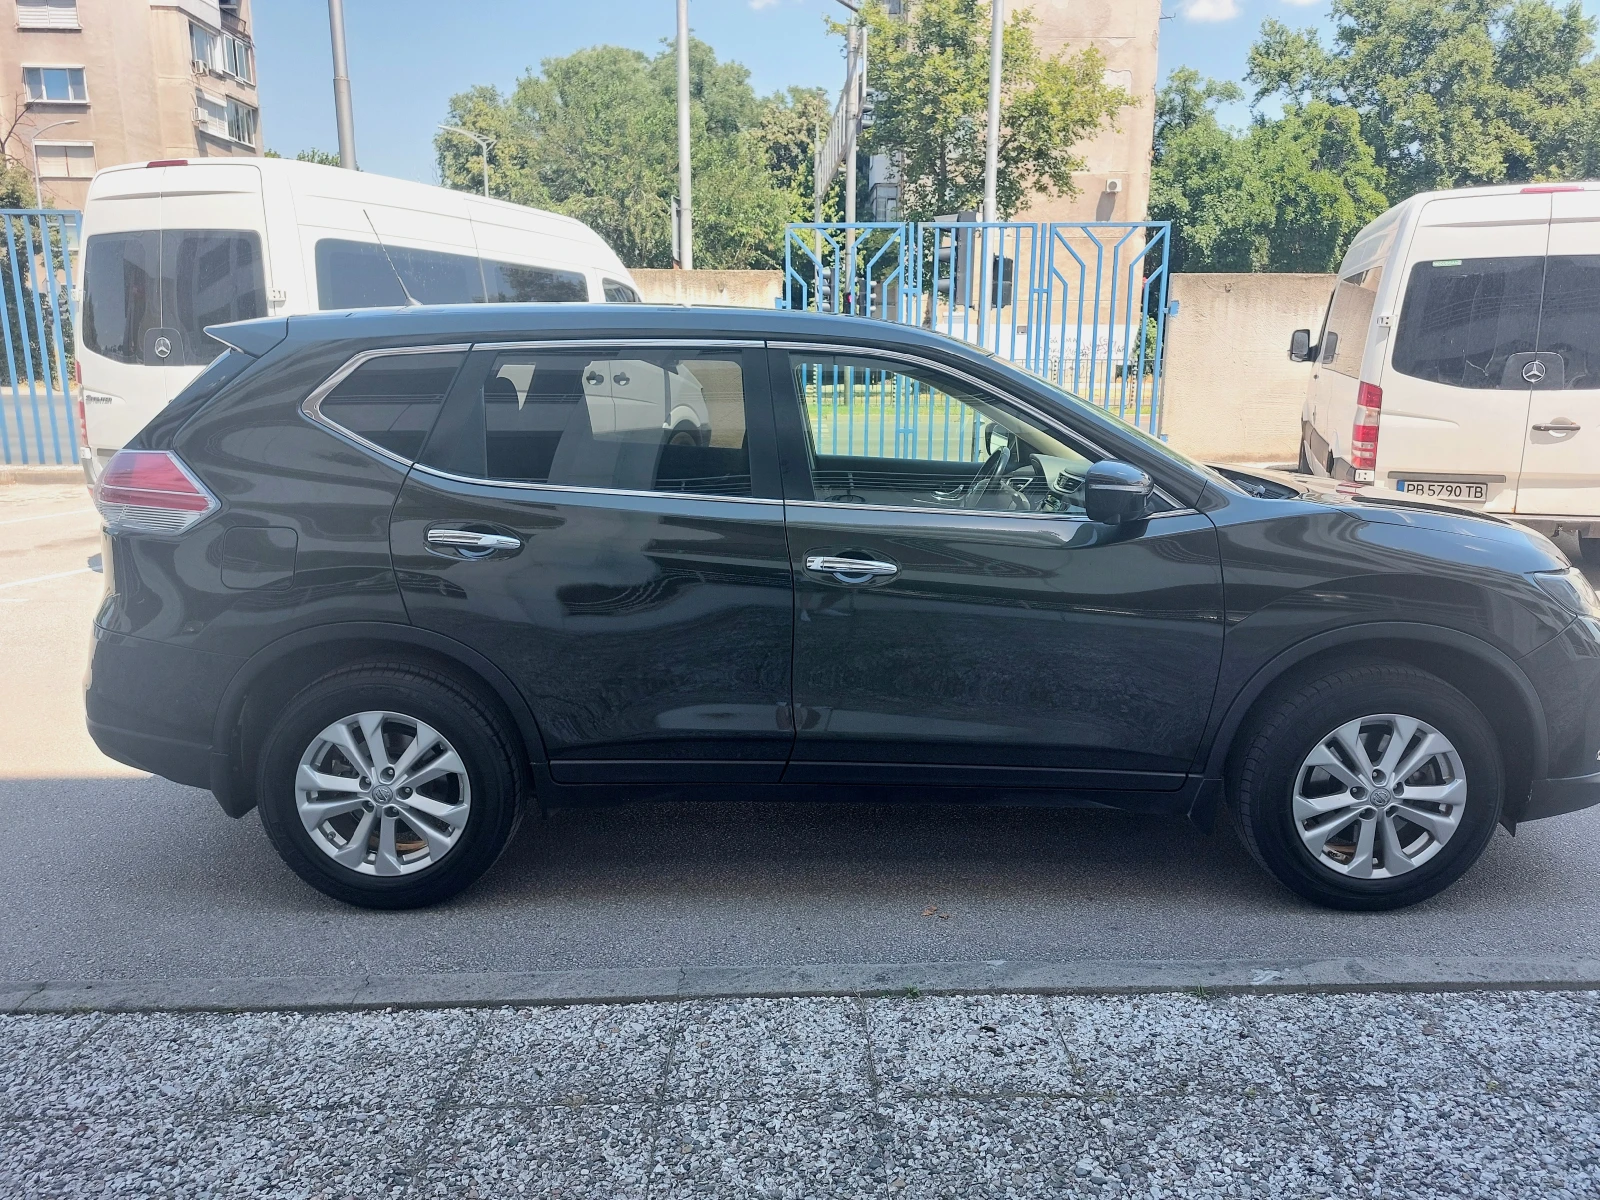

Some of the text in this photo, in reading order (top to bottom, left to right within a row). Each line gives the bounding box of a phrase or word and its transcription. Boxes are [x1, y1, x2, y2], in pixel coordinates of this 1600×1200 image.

[1407, 484, 1483, 498] PB 5790 TB
